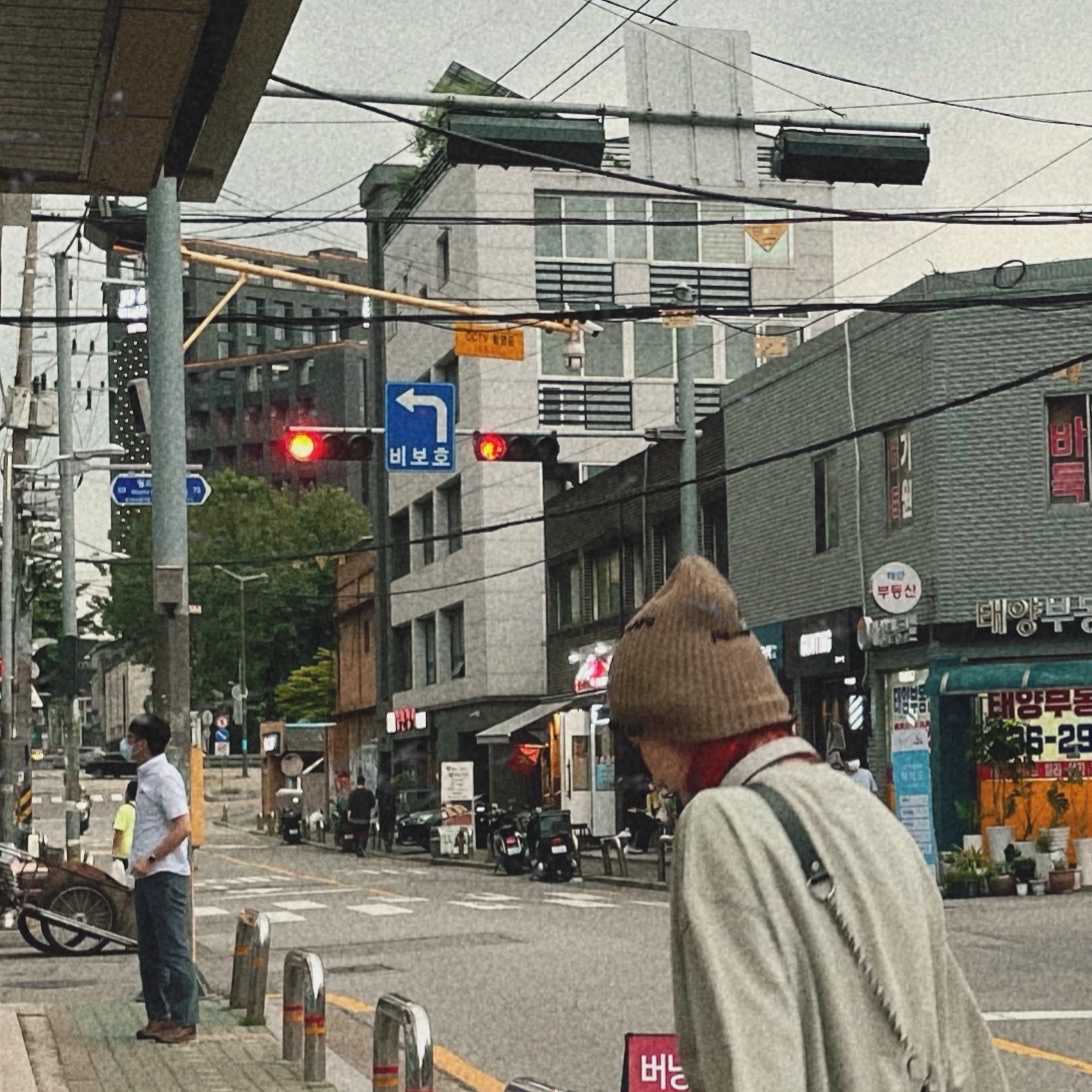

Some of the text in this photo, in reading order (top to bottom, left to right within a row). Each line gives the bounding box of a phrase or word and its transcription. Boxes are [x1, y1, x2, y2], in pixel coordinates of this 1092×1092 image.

[466, 331, 489, 343] CCTV
[389, 445, 451, 467] 비보호
[1051, 416, 1087, 503] 바둑
[877, 585, 917, 600] 부동산
